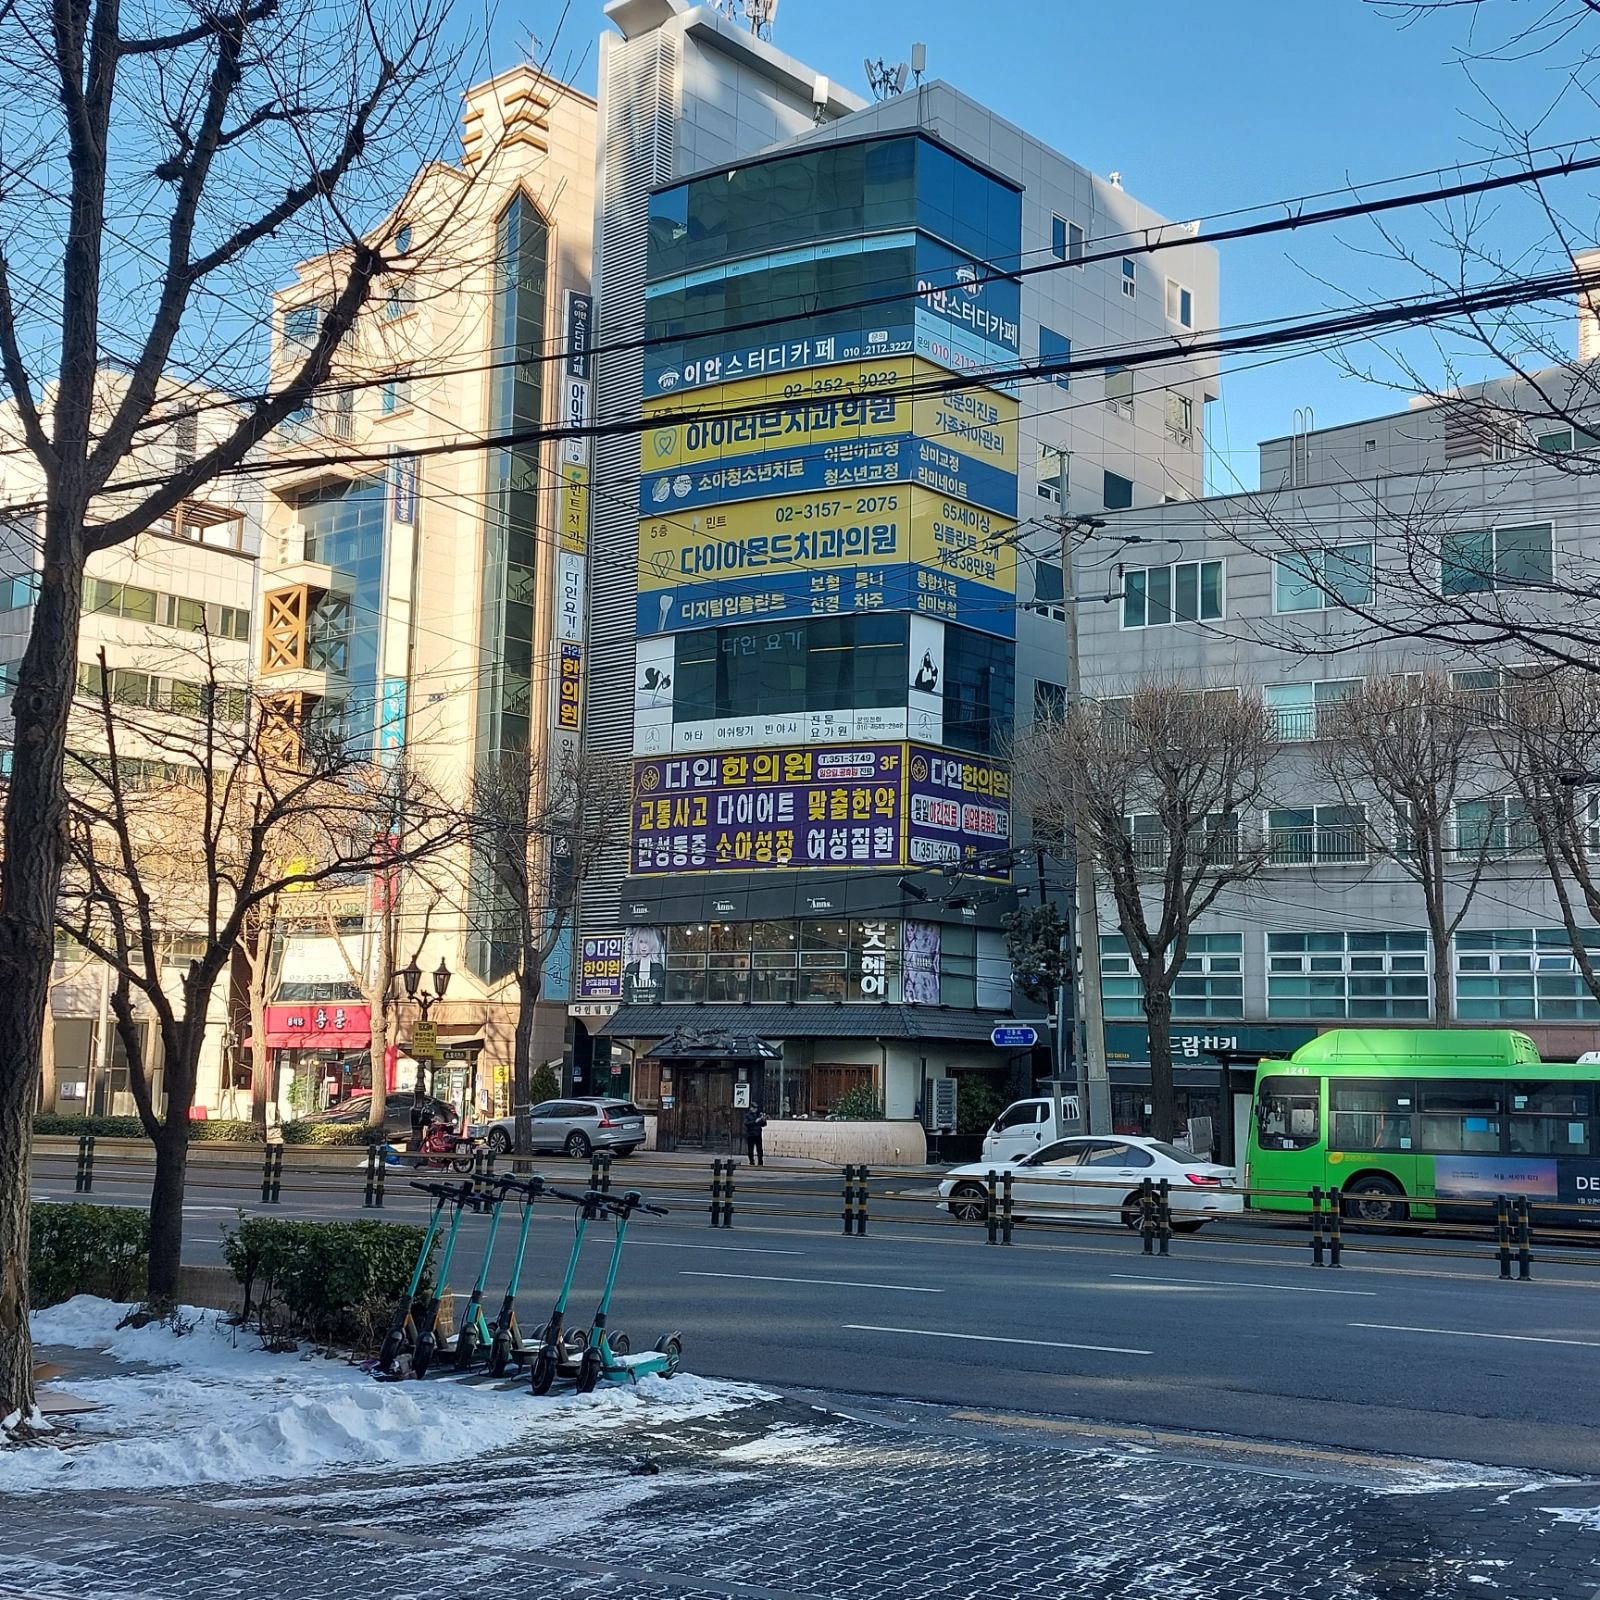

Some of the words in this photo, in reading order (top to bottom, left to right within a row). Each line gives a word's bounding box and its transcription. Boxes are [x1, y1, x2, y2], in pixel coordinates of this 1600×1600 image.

[917, 280, 1017, 348] 이안스터디카페
[843, 347, 860, 358] 010
[871, 332, 886, 342] 문의
[932, 342, 949, 360] 010
[684, 337, 835, 384] 이안스터디카페
[824, 441, 899, 462] 어린이교정
[919, 443, 959, 473] 심미교정
[698, 459, 804, 492] 소아청소년치료
[824, 462, 899, 486] 청소년교정
[918, 466, 968, 498] 라미네이트
[706, 515, 727, 530] 민트
[775, 495, 898, 523] 02-3157-2075
[942, 502, 991, 534] 65세이상
[680, 524, 897, 574] 다이아몬드치과의원
[563, 572, 580, 629] 다인요가
[681, 593, 787, 620] 디지털임플란트
[560, 657, 580, 725] 한의원
[765, 722, 797, 735] 빈야사
[810, 725, 848, 738] 요가원
[665, 752, 812, 789] 다인한의원
[880, 756, 899, 771] 3F
[931, 757, 1009, 799] 다인한의원
[638, 796, 707, 830] 교통사고
[717, 792, 795, 825] 다이어트
[808, 788, 895, 822] 맞춤한약
[807, 826, 894, 861] 여성질환
[597, 940, 620, 957] 다인
[861, 918, 887, 995] 안스헤어
[584, 960, 620, 978] 한의원
